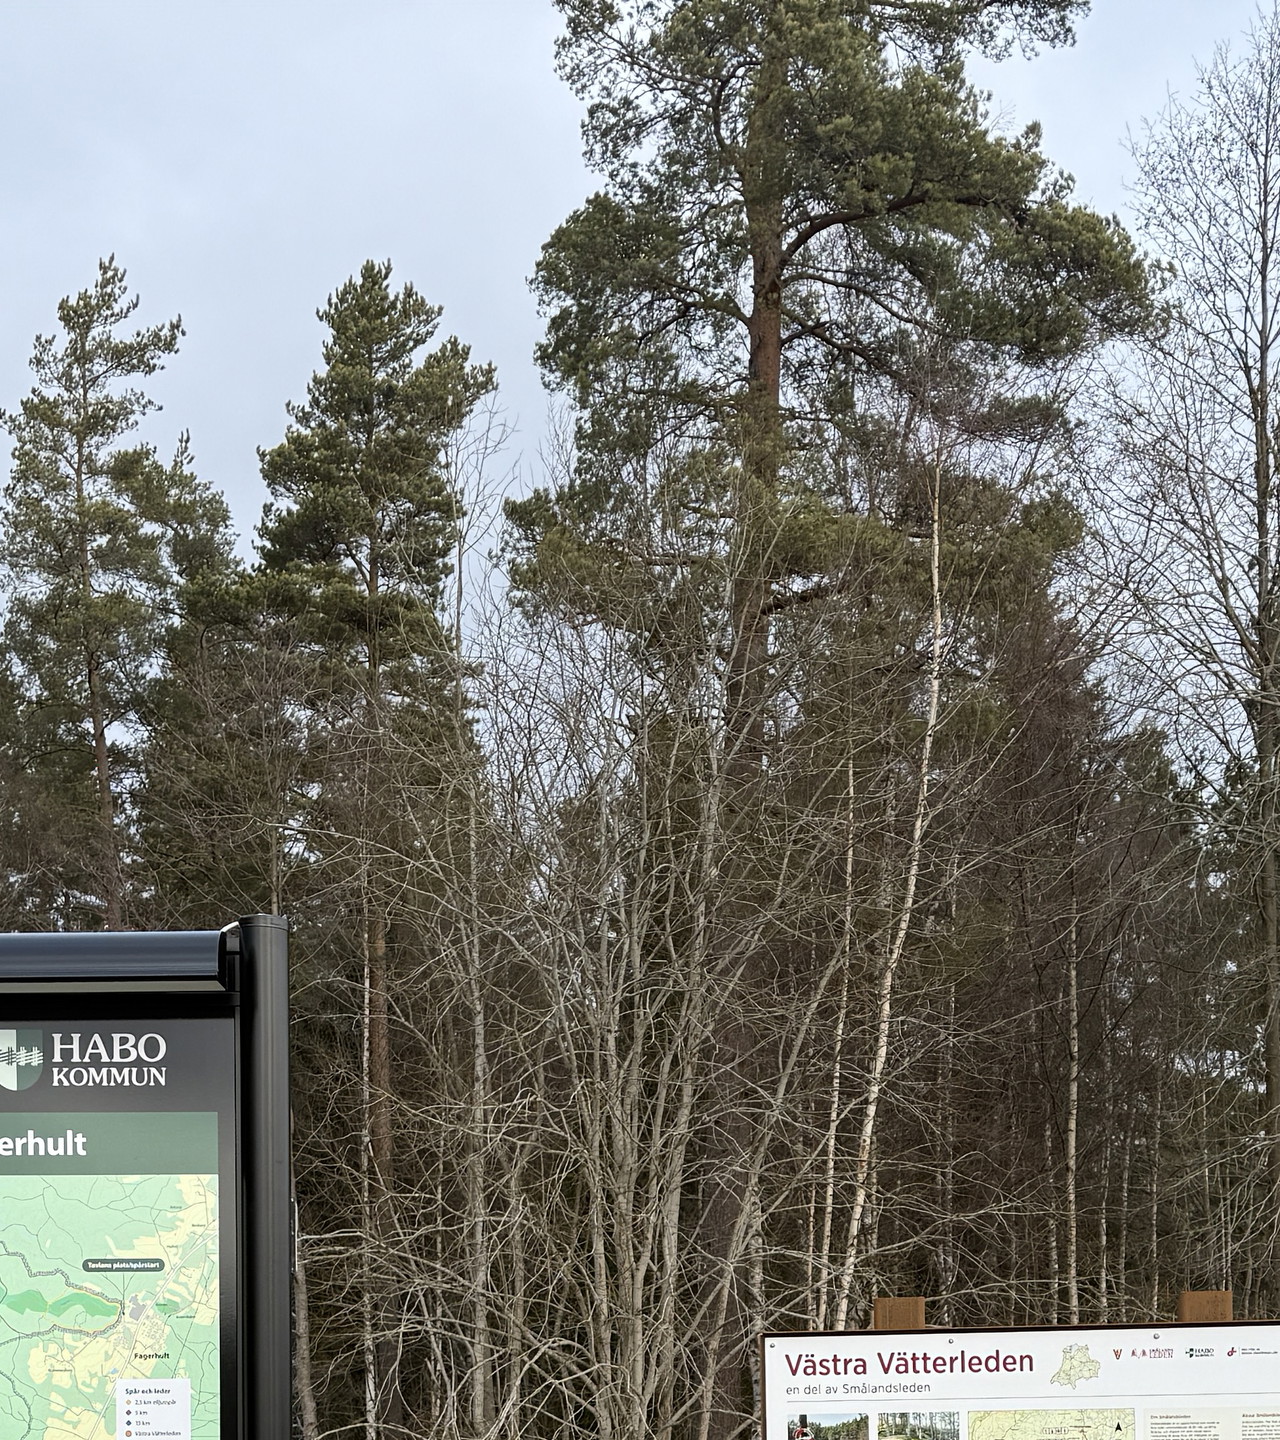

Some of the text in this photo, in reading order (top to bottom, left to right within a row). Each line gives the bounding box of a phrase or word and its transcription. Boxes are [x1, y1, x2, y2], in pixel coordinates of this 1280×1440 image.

[51, 1032, 166, 1063] HABO
[52, 1067, 166, 1086] KOMMUN
[134, 1352, 169, 1360] Fagerhult
[784, 1349, 1033, 1376] Västra Vätterleden
[785, 1381, 930, 1395] en del av Smålandsleden
